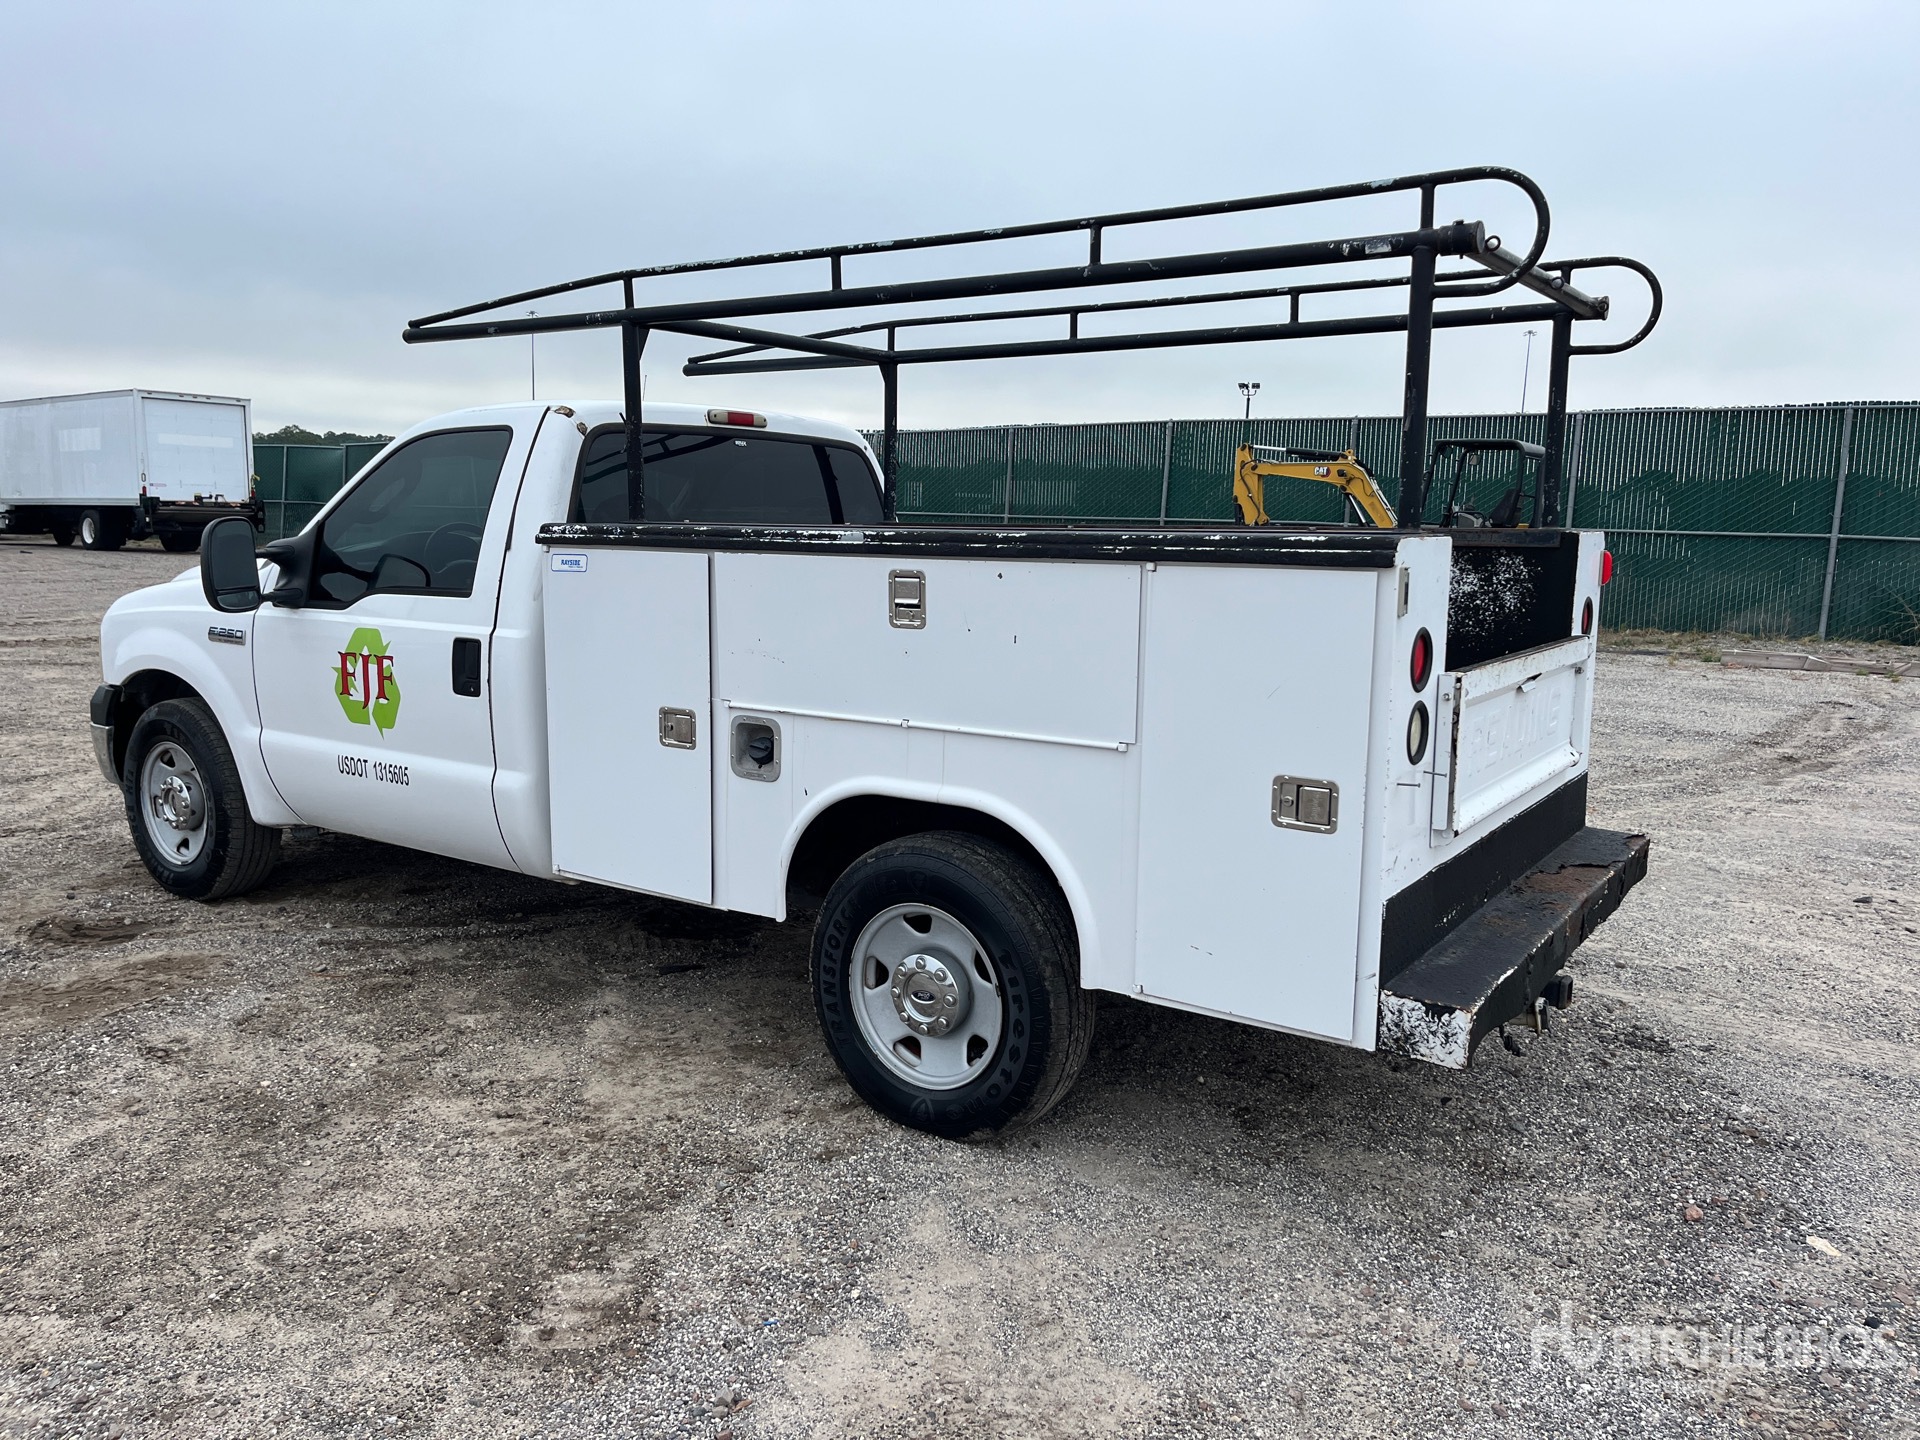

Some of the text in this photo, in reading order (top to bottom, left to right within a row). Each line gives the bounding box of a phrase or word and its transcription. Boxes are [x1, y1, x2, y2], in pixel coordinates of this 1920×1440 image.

[1314, 466, 1328, 476] CAT
[337, 651, 394, 709] FJF
[337, 754, 410, 786] USDOT 1315605
